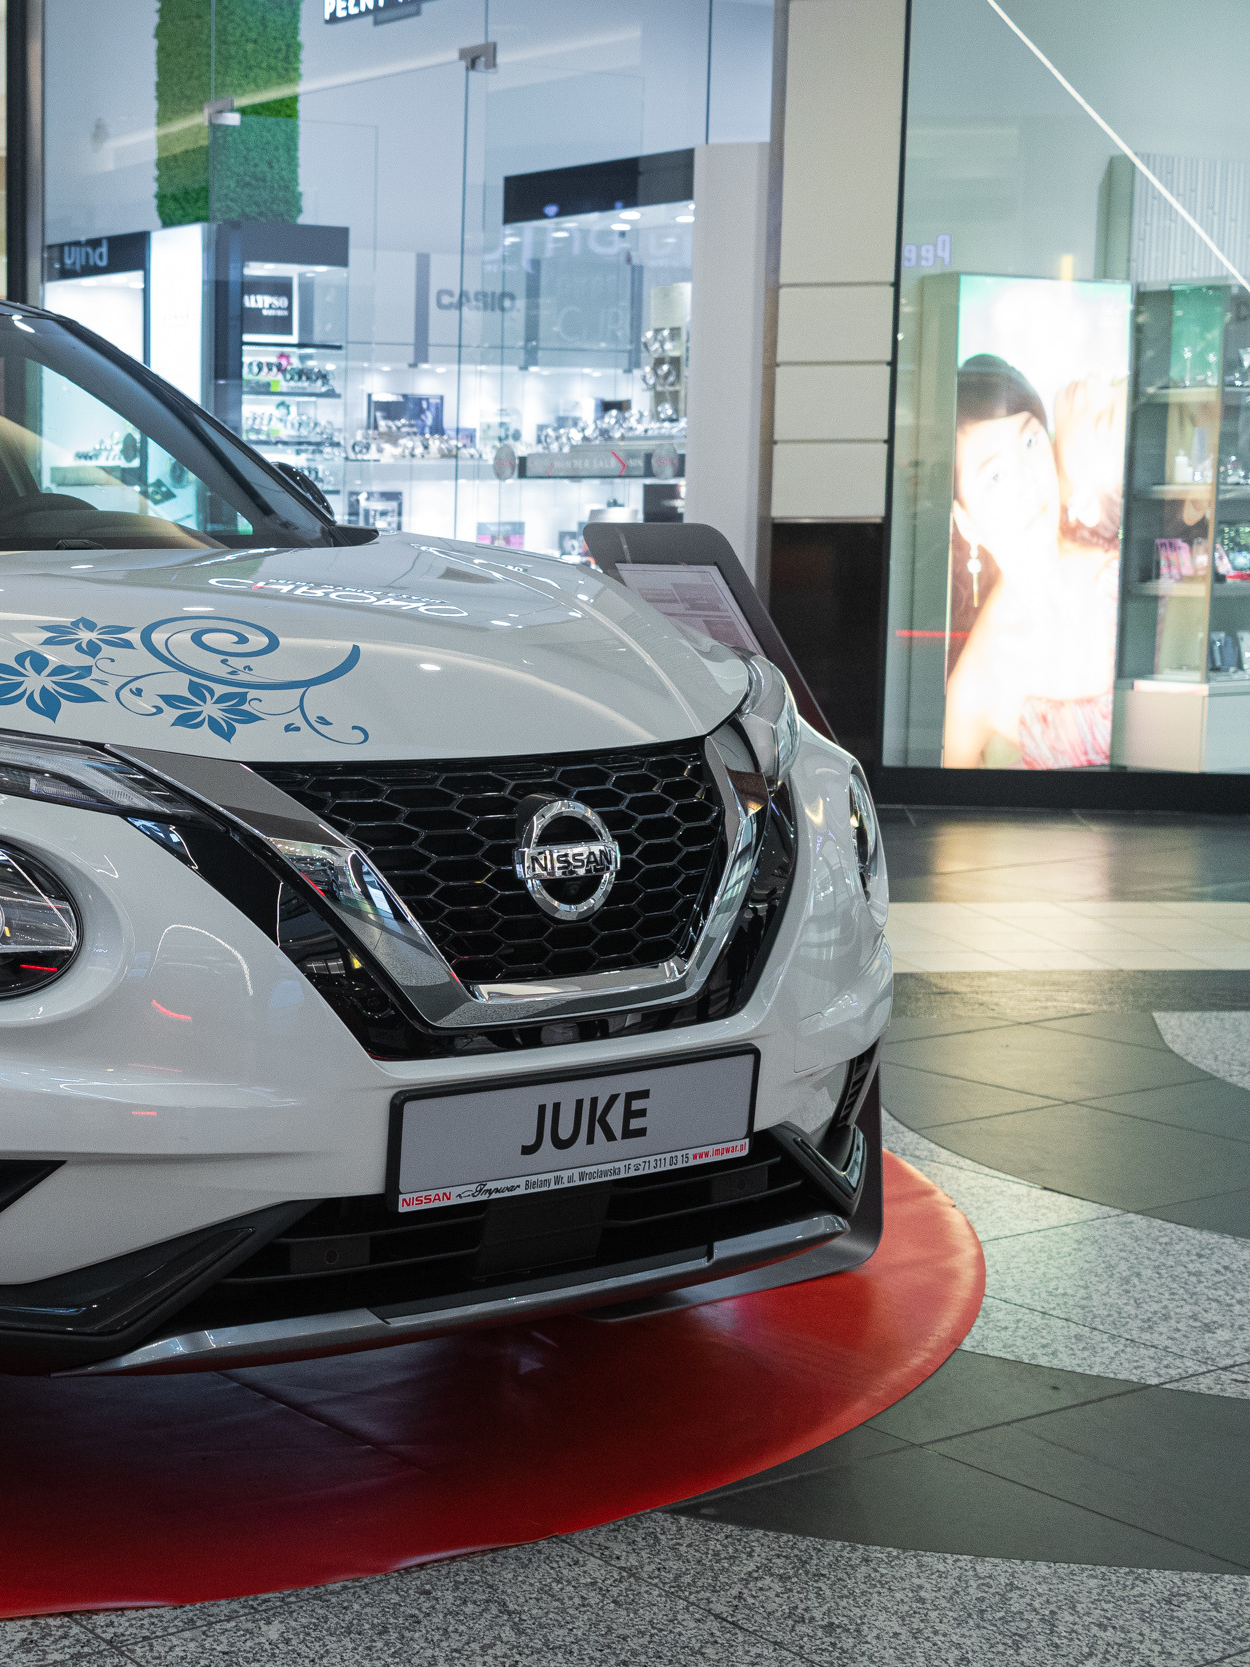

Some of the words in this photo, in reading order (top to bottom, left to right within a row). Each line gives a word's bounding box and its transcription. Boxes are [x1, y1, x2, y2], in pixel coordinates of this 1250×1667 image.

[435, 288, 517, 313] CASIO
[529, 848, 613, 873] NISSAN
[520, 1088, 651, 1156] JUKE
[401, 1191, 452, 1208] NISSAN
[524, 1176, 552, 1191] Bielany
[553, 1174, 565, 1186] Wr.
[567, 1172, 576, 1184] ul.
[578, 1165, 622, 1183] Wrocławska
[623, 1163, 632, 1175] 1F
[642, 1160, 651, 1172] 71
[653, 1157, 667, 1170] 311
[669, 1155, 679, 1167] 03
[681, 1153, 690, 1165] 15
[692, 1141, 747, 1161] www.impwar.pl
